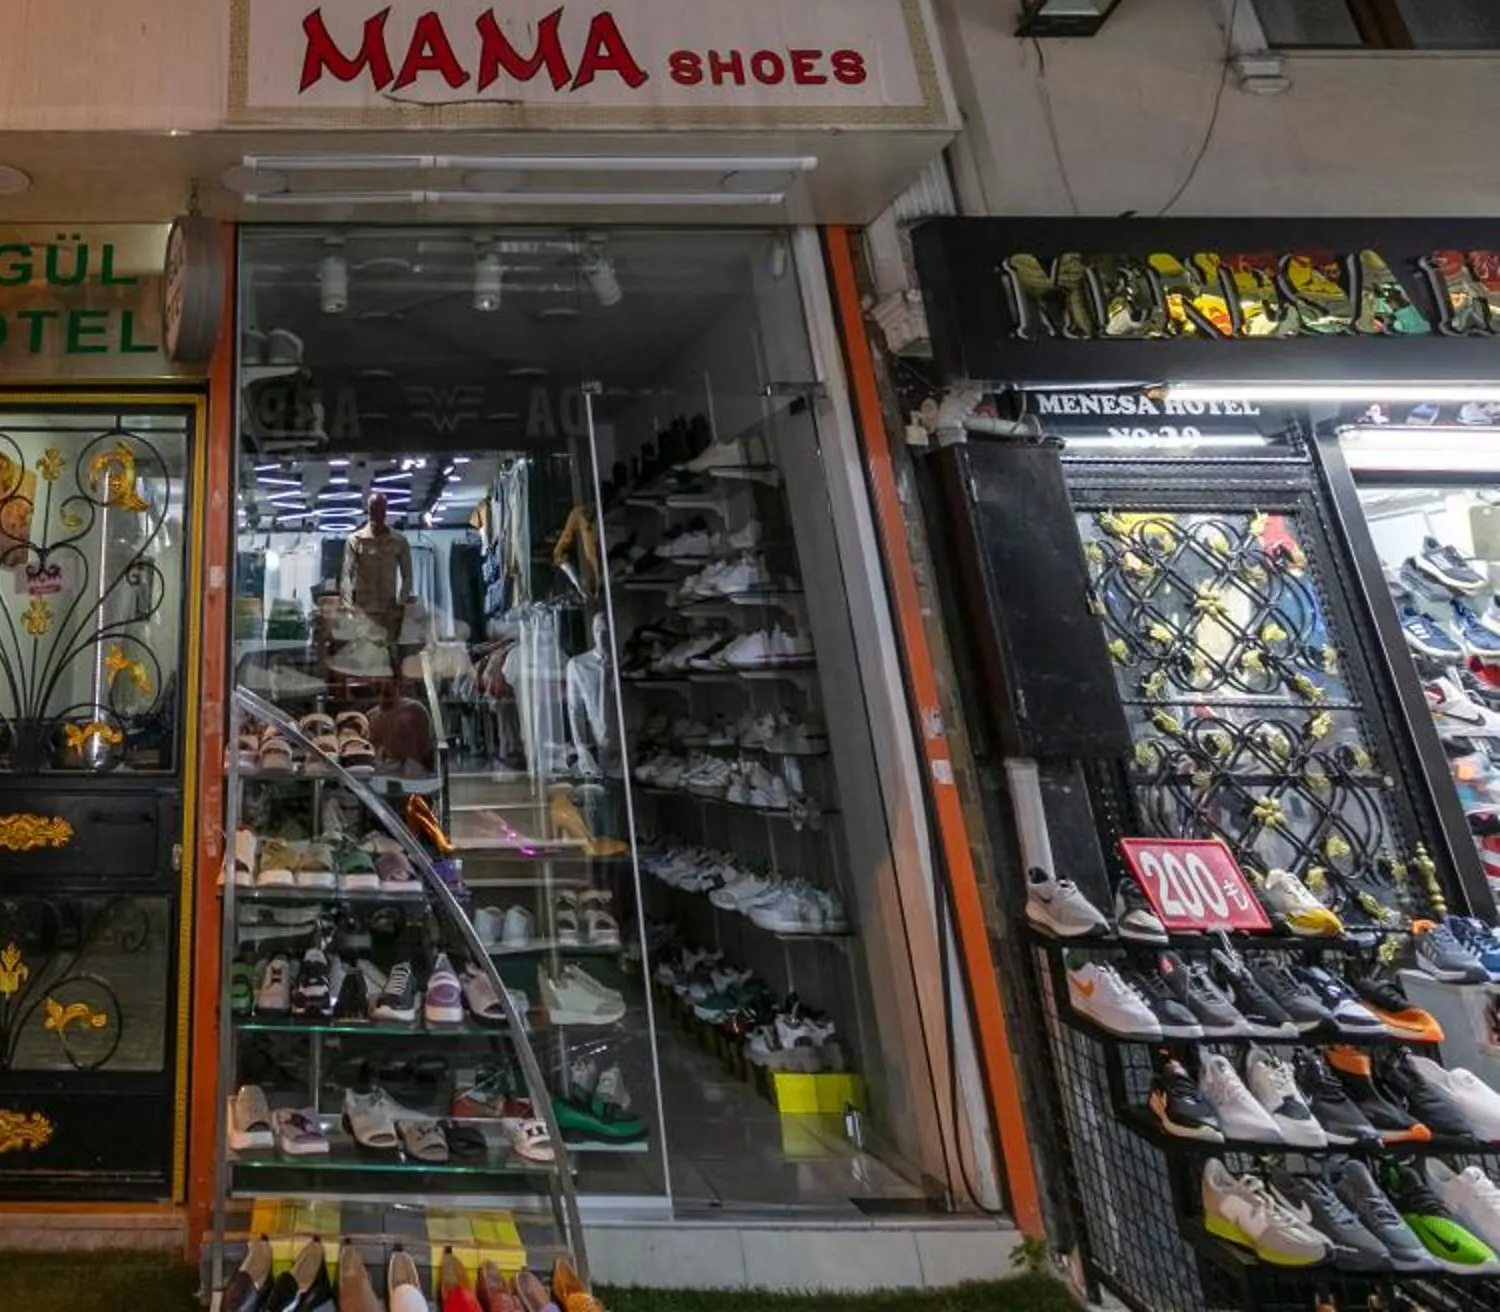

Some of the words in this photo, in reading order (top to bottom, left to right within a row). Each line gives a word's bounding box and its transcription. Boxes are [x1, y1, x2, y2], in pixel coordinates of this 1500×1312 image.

[299, 5, 649, 93] MAMA
[667, 48, 867, 86] SHOES
[1034, 393, 1160, 416] MENESA
